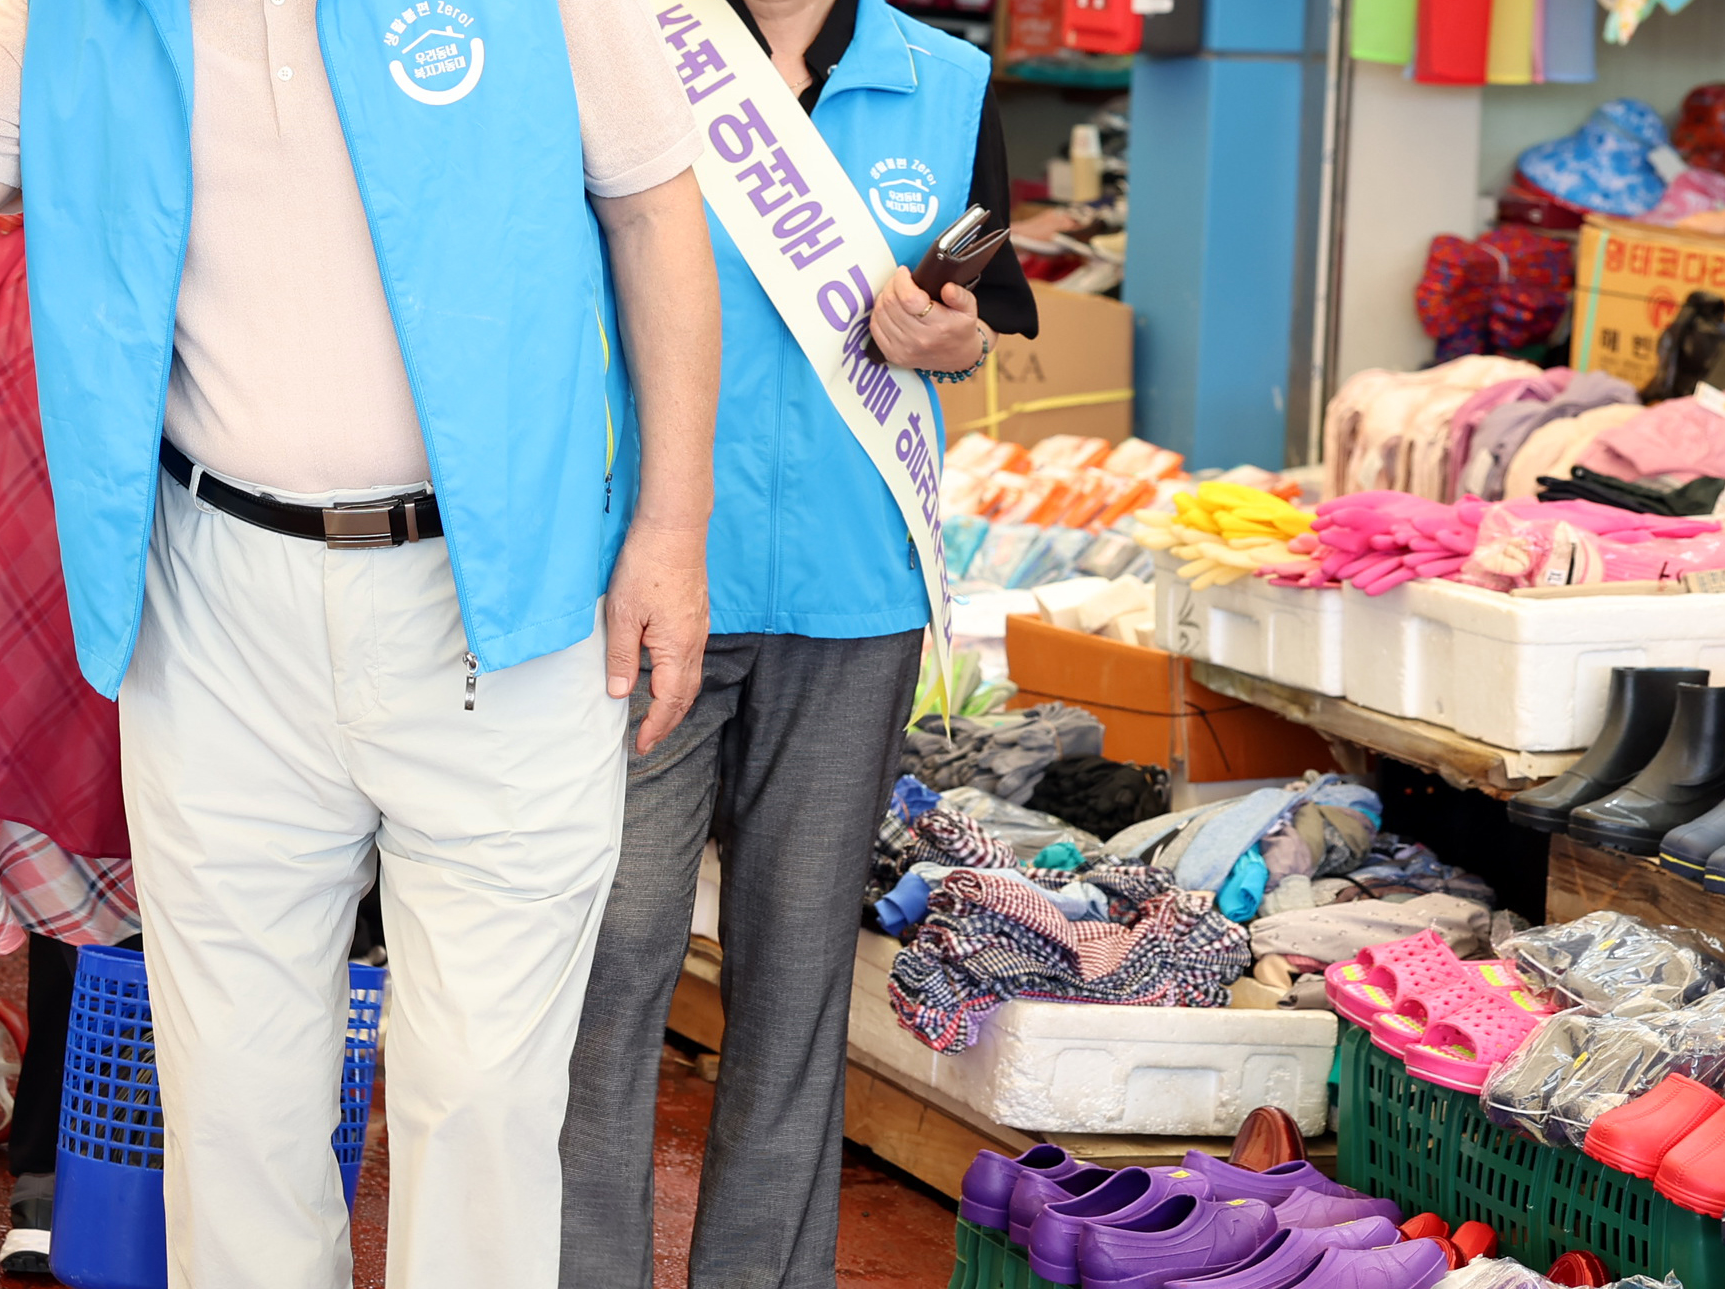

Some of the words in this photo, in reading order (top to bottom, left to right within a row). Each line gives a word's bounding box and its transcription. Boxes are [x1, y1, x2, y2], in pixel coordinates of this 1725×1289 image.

[383, 1, 430, 47] 생활불편
[437, 0, 475, 28] Zero!
[413, 55, 467, 80] 복지기동대
[415, 43, 459, 66] 우리동네
[708, 98, 845, 271] 어려운
[910, 158, 937, 186] Zero!
